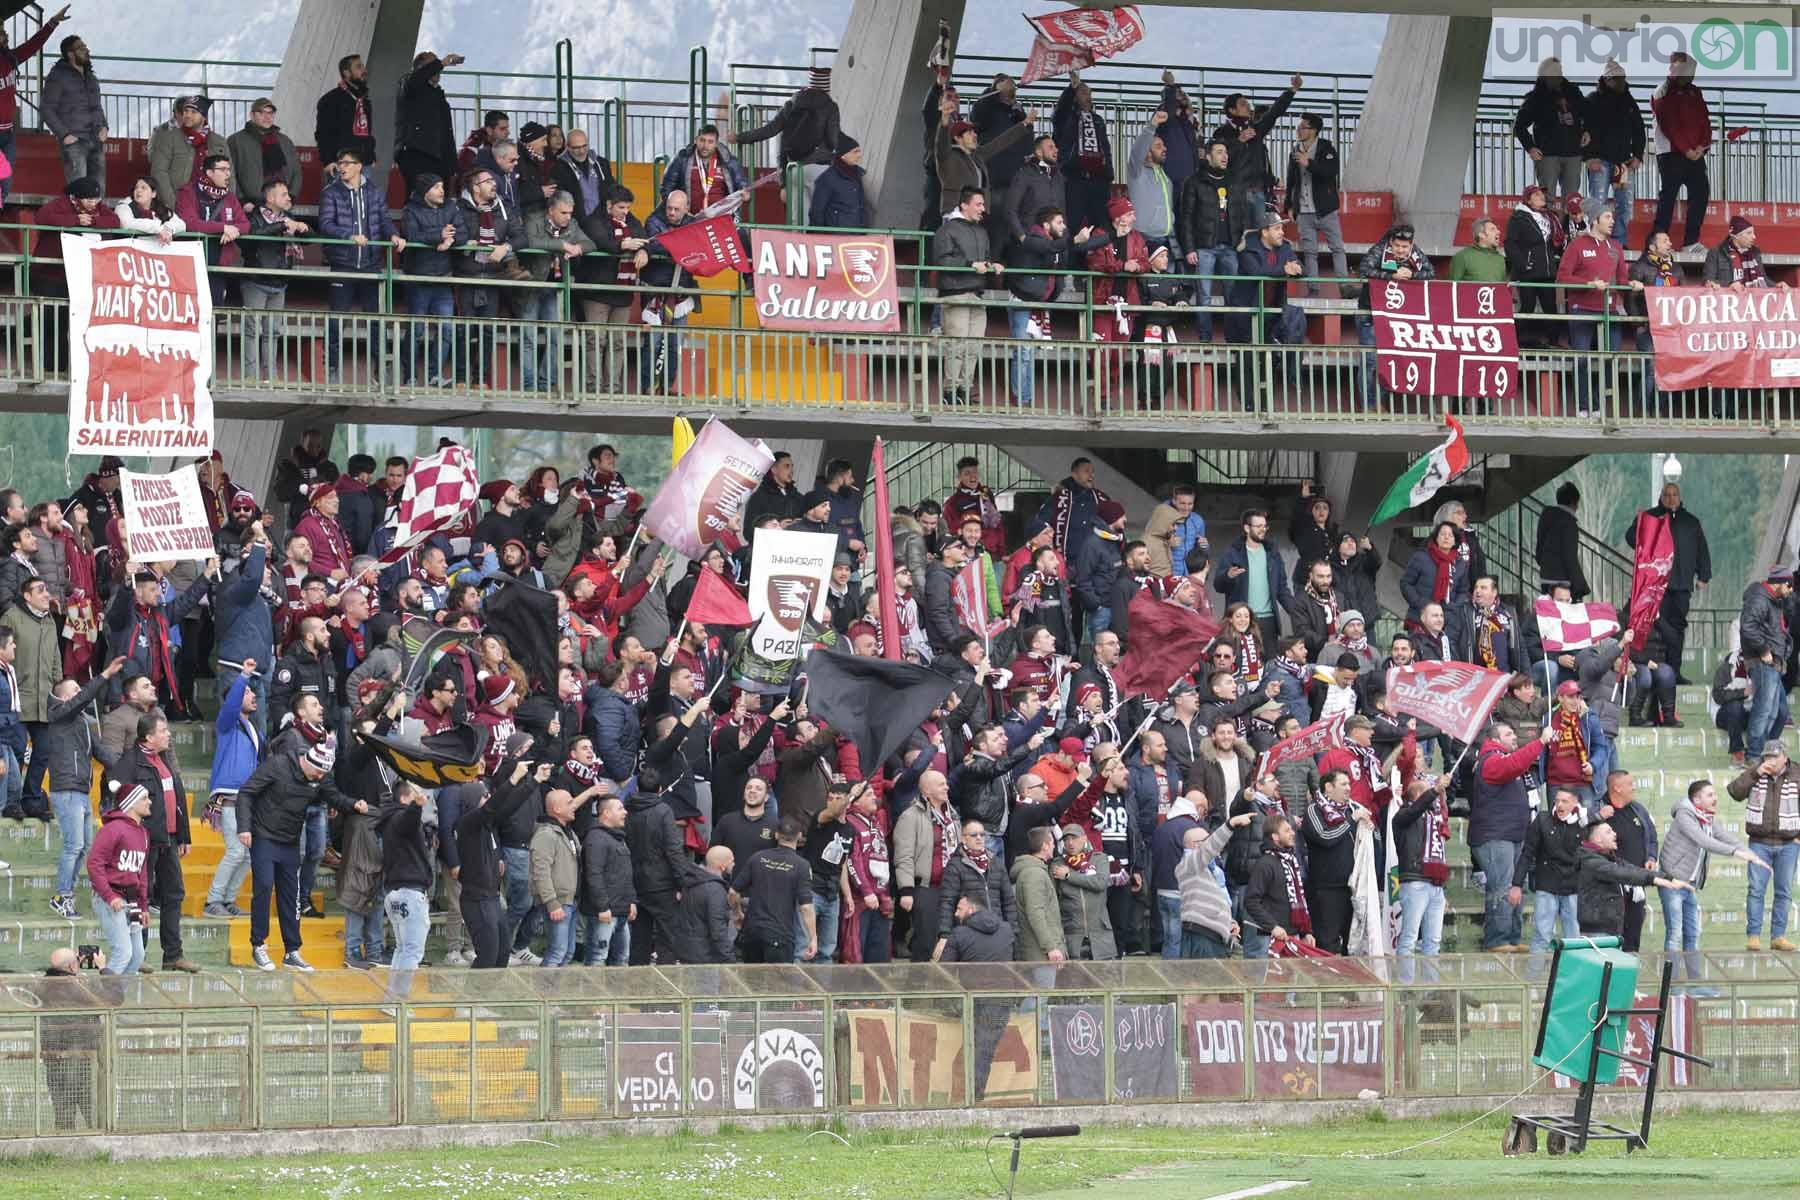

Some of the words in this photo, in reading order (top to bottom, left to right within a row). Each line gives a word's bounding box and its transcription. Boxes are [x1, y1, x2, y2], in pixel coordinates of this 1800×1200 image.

[117, 251, 170, 288] CLUB
[757, 241, 833, 278] ANF
[95, 286, 129, 318] MAI
[146, 287, 196, 325] SOLA
[760, 284, 896, 322] Salerno
[1389, 320, 1503, 353] RAITO
[1687, 331, 1748, 353] CLUB
[1388, 360, 1419, 392] 19
[1478, 365, 1508, 397] 19
[76, 427, 209, 448] SALERNITANA
[131, 479, 178, 502] FINCHE
[137, 501, 183, 528] MORTE
[130, 532, 158, 555] NON
[155, 530, 173, 551] CI
[779, 608, 802, 619] 1919
[1293, 1020, 1385, 1065] VESTUT
[655, 1052, 674, 1075] CI
